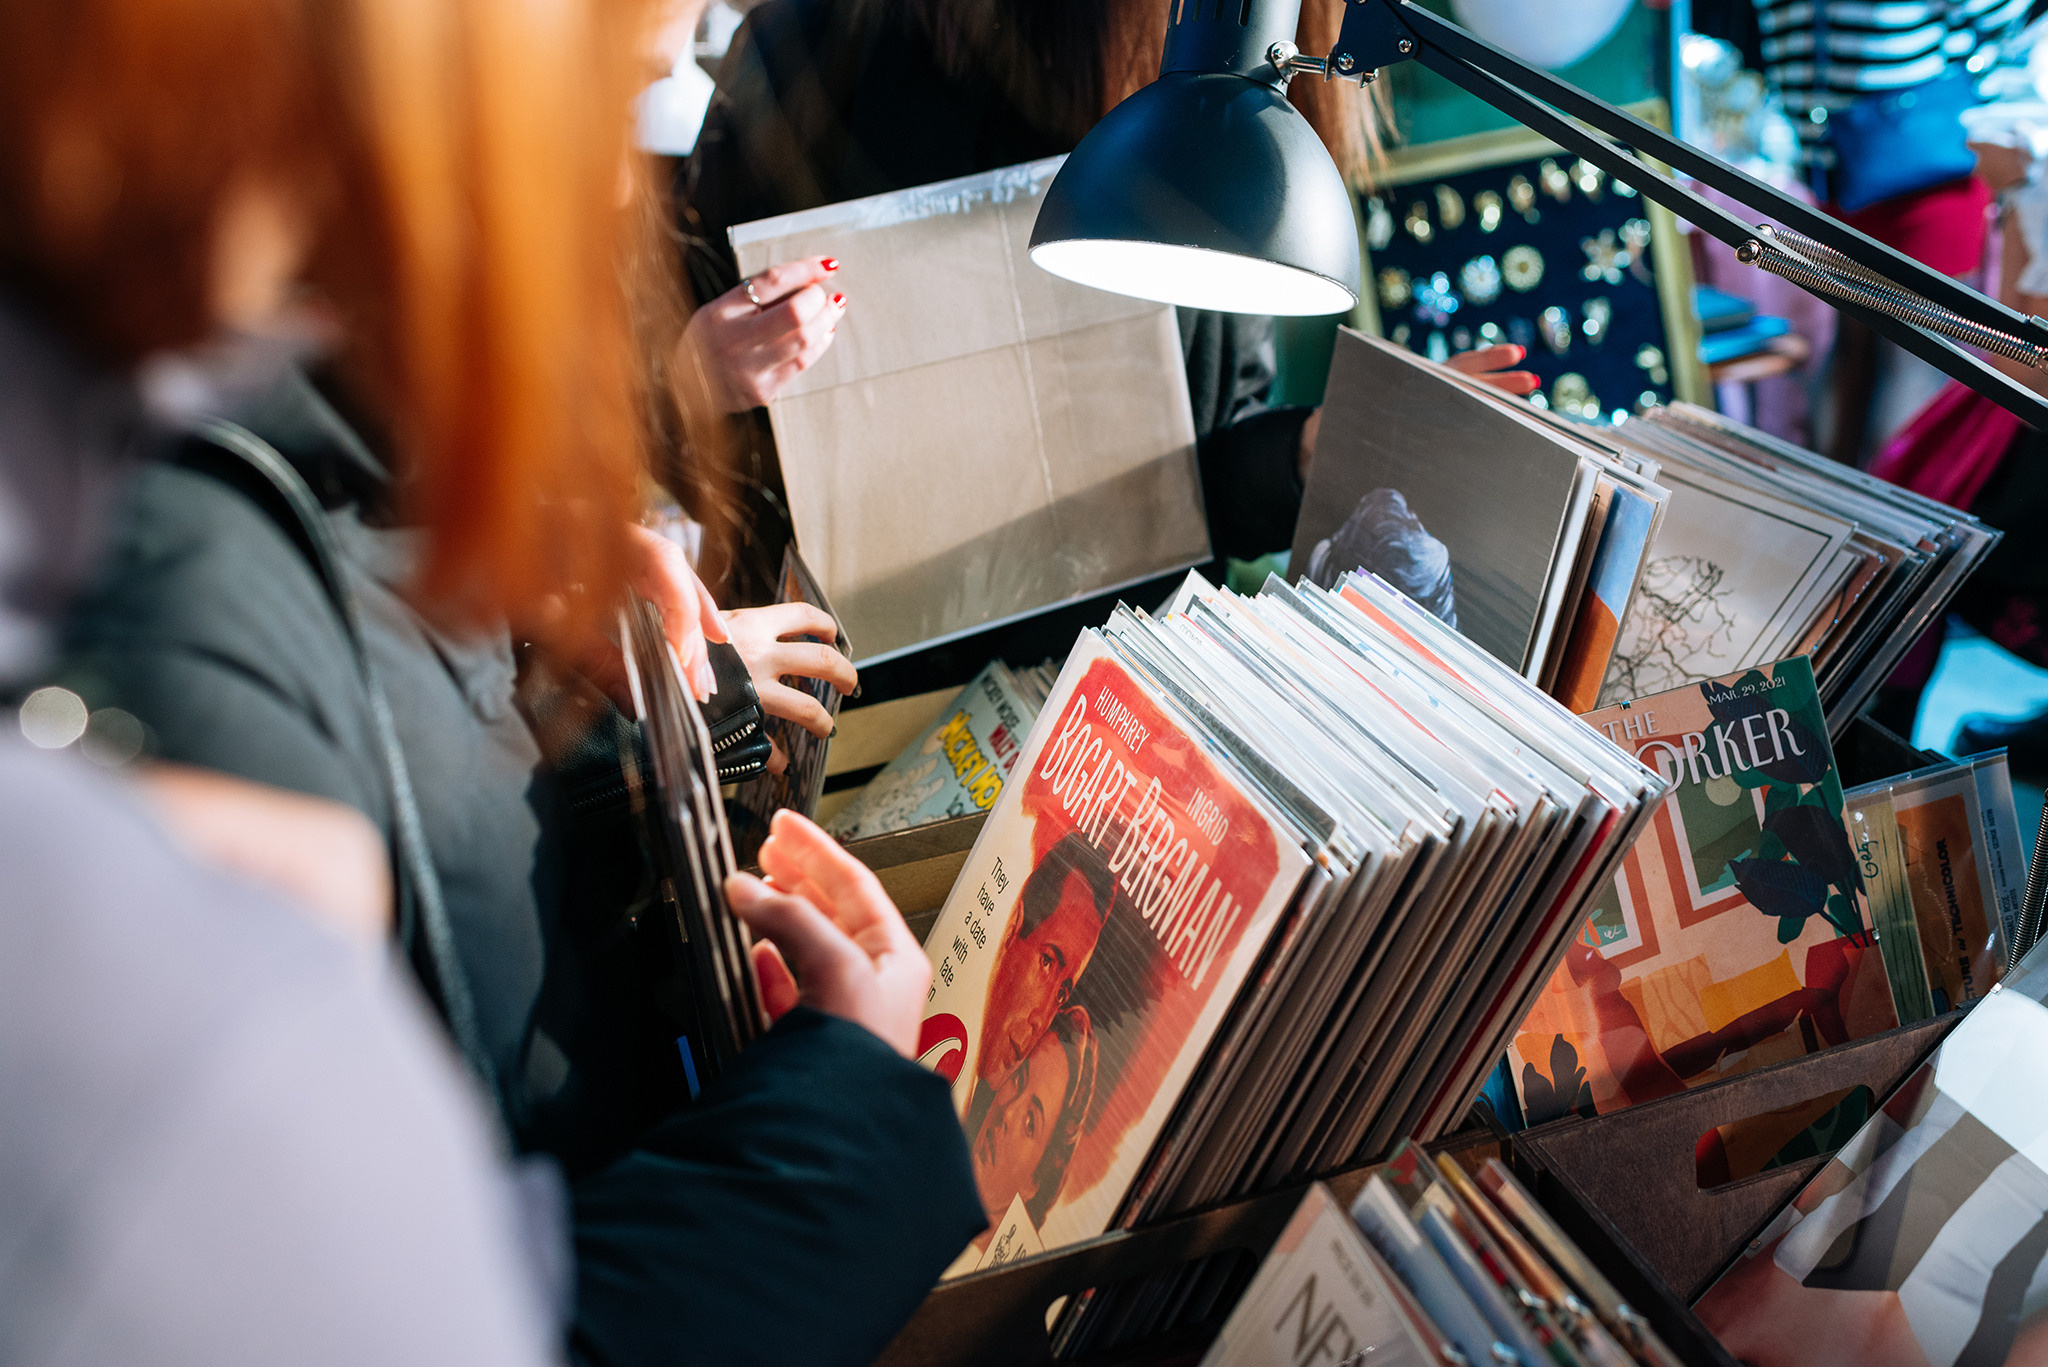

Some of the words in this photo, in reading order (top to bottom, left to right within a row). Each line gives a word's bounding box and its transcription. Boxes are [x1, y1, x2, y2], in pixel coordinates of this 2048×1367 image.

[1709, 690, 1740, 705] MAR.
[1742, 684, 1759, 697] 29,
[1760, 676, 1786, 691] 2021
[1094, 686, 1150, 754] HUMPHREY
[1601, 710, 1661, 743] THE
[1632, 708, 1807, 796] ORKER
[1185, 788, 1228, 846] INGRID
[1040, 694, 1137, 850] BOGART
[1108, 775, 1242, 990] BERGMAN
[991, 856, 1009, 894] They
[1936, 838, 1963, 935] TECHNICOLOR
[976, 882, 995, 916] have
[964, 911, 973, 925] a
[970, 918, 987, 949] date
[953, 935, 968, 965] with
[939, 956, 954, 987] fate
[1959, 955, 1977, 1000] CTURE
